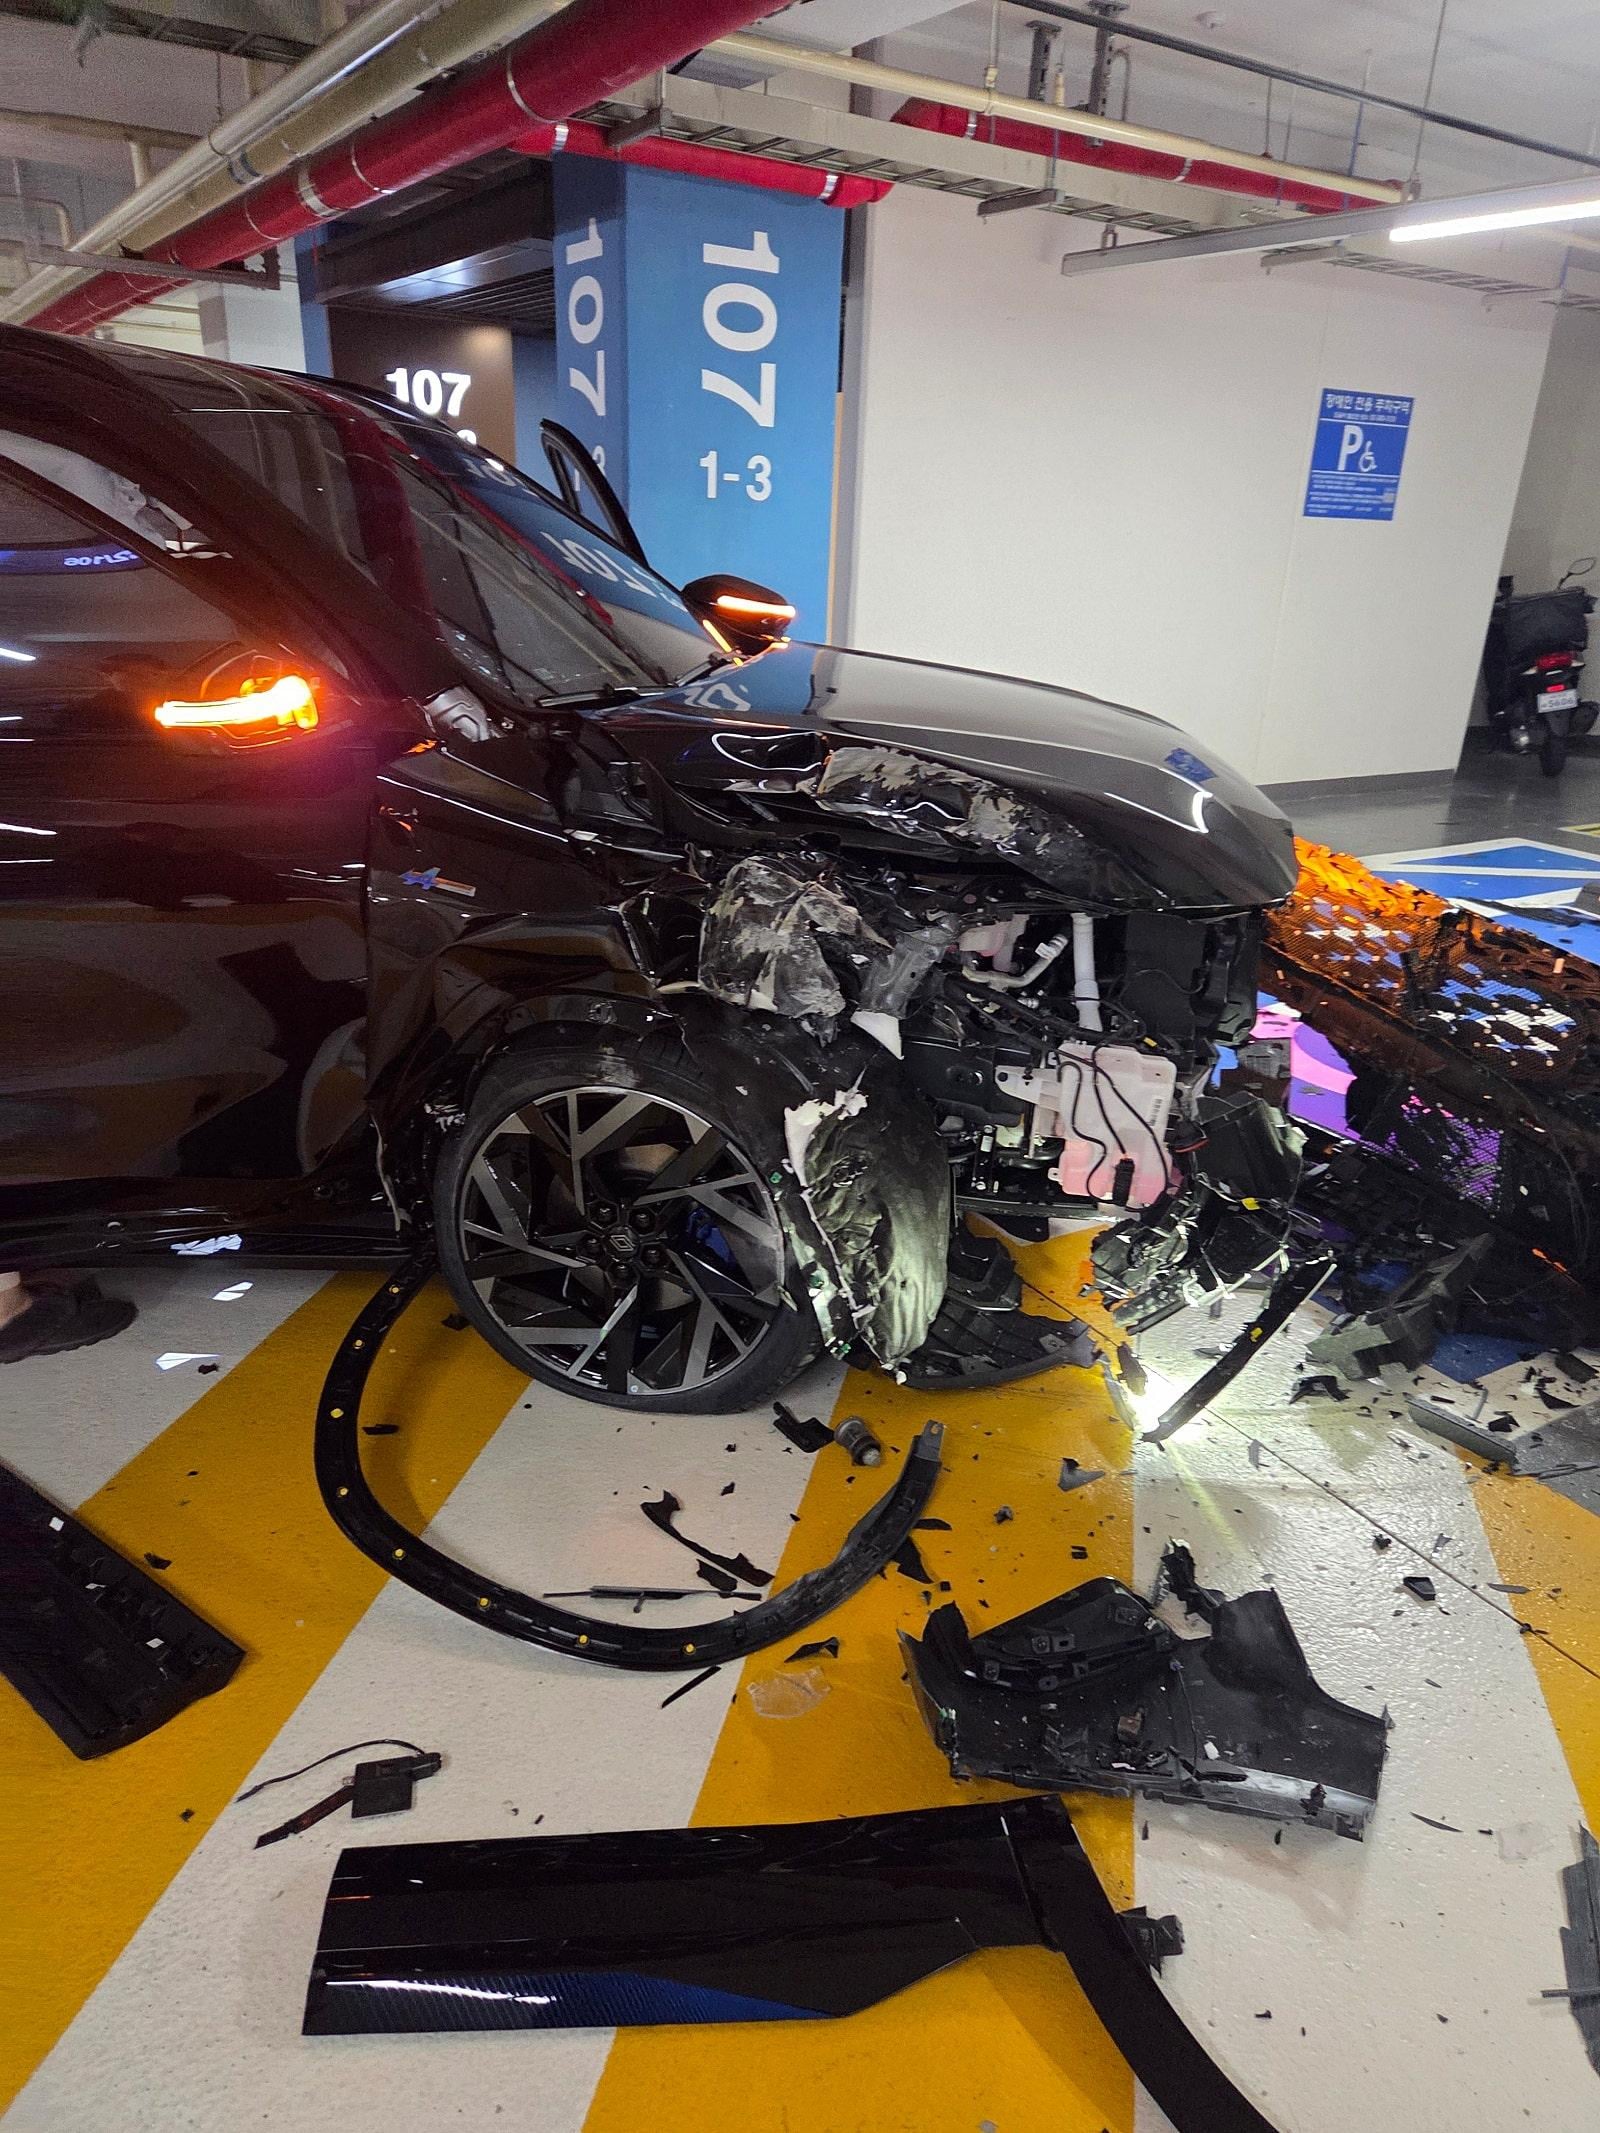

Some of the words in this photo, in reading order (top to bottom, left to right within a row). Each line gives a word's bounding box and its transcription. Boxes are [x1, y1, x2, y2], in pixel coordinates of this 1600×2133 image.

[566, 218, 606, 416] 107
[701, 231, 780, 428] 107
[386, 368, 471, 417] 107
[1337, 424, 1364, 471] P
[700, 450, 772, 501] 1-3
